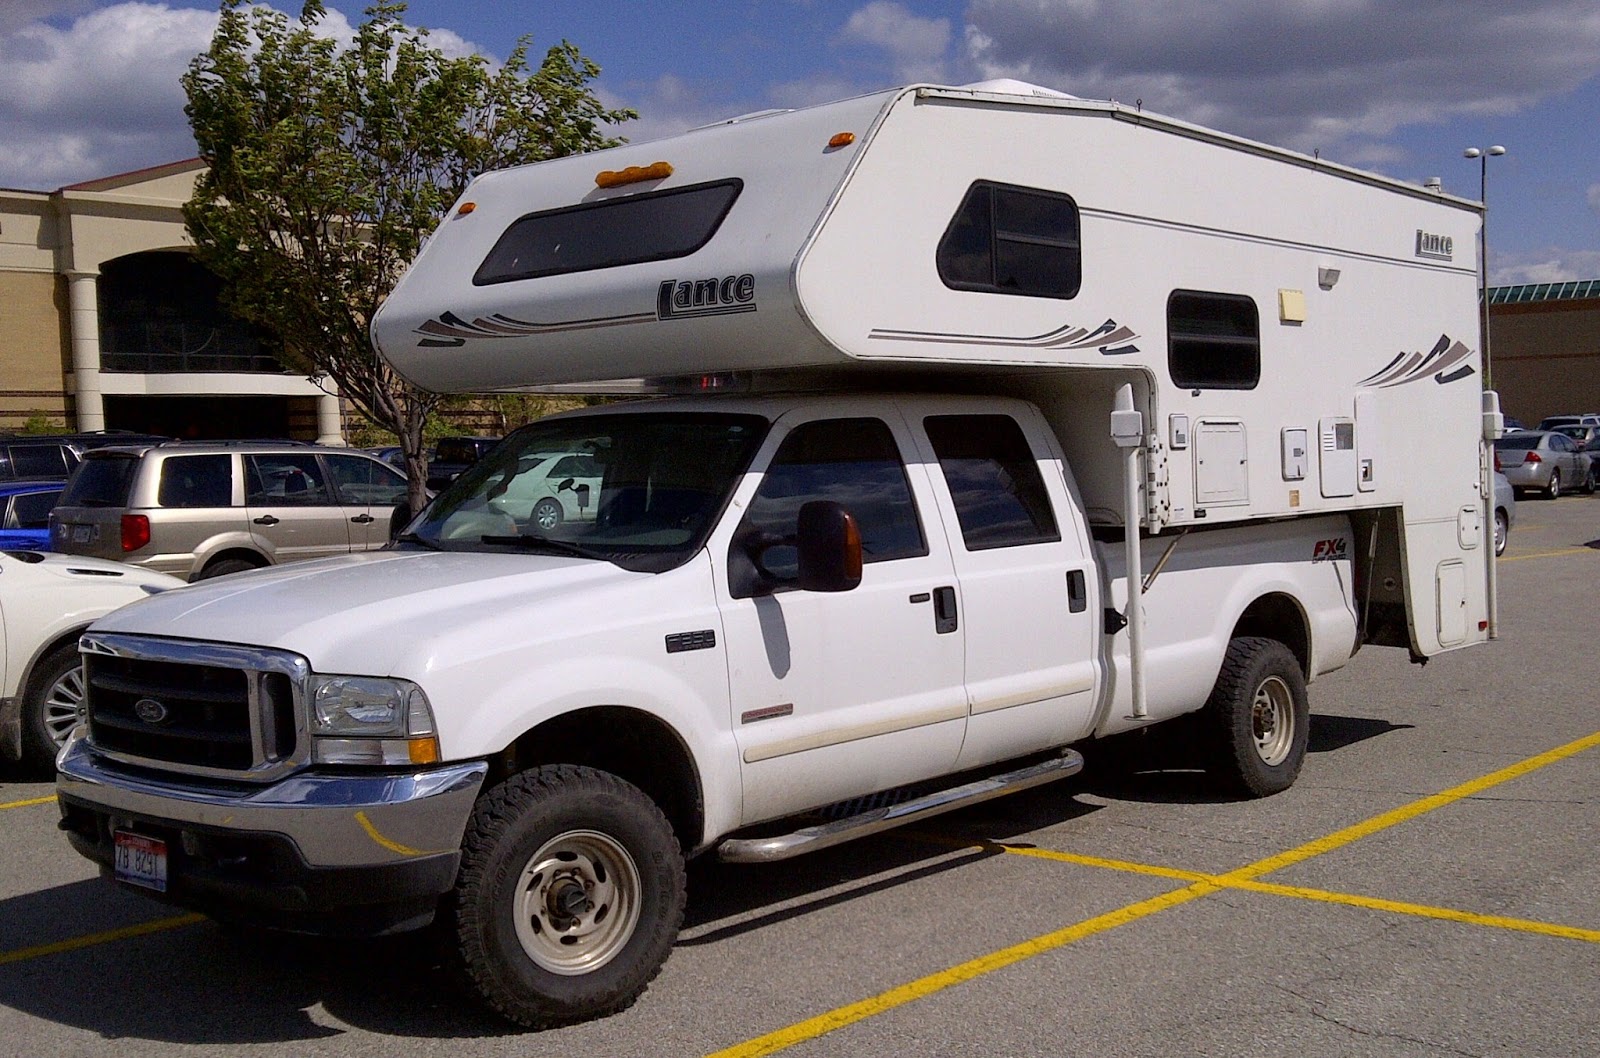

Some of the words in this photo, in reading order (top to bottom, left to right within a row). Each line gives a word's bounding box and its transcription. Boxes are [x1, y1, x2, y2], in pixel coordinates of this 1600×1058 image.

[1415, 229, 1452, 262] Lance
[657, 273, 757, 321] Lance
[1313, 538, 1347, 557] FX4
